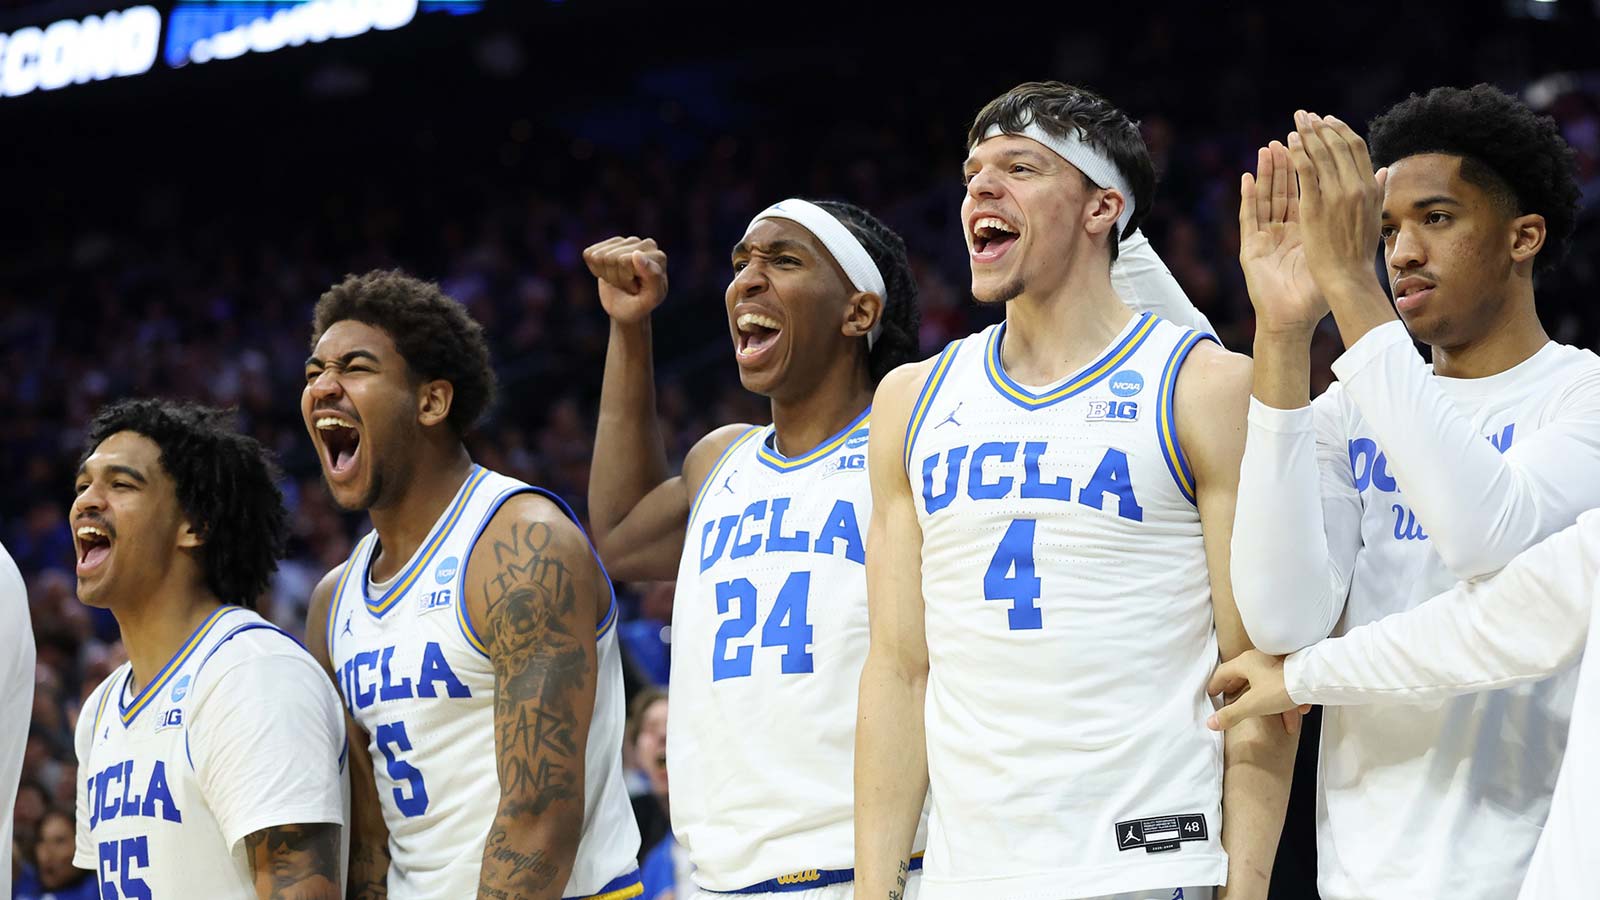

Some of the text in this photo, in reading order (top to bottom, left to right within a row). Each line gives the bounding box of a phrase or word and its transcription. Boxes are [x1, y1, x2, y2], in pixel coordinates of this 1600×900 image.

[922, 441, 1143, 523] UCLA
[493, 521, 553, 565] NO
[700, 497, 866, 575] UCLA
[983, 518, 1043, 630] 4
[712, 571, 814, 682] 24
[335, 641, 473, 718] UCLA
[87, 760, 183, 832] UCLA
[376, 720, 429, 818] 5
[1184, 821, 1200, 832] 48
